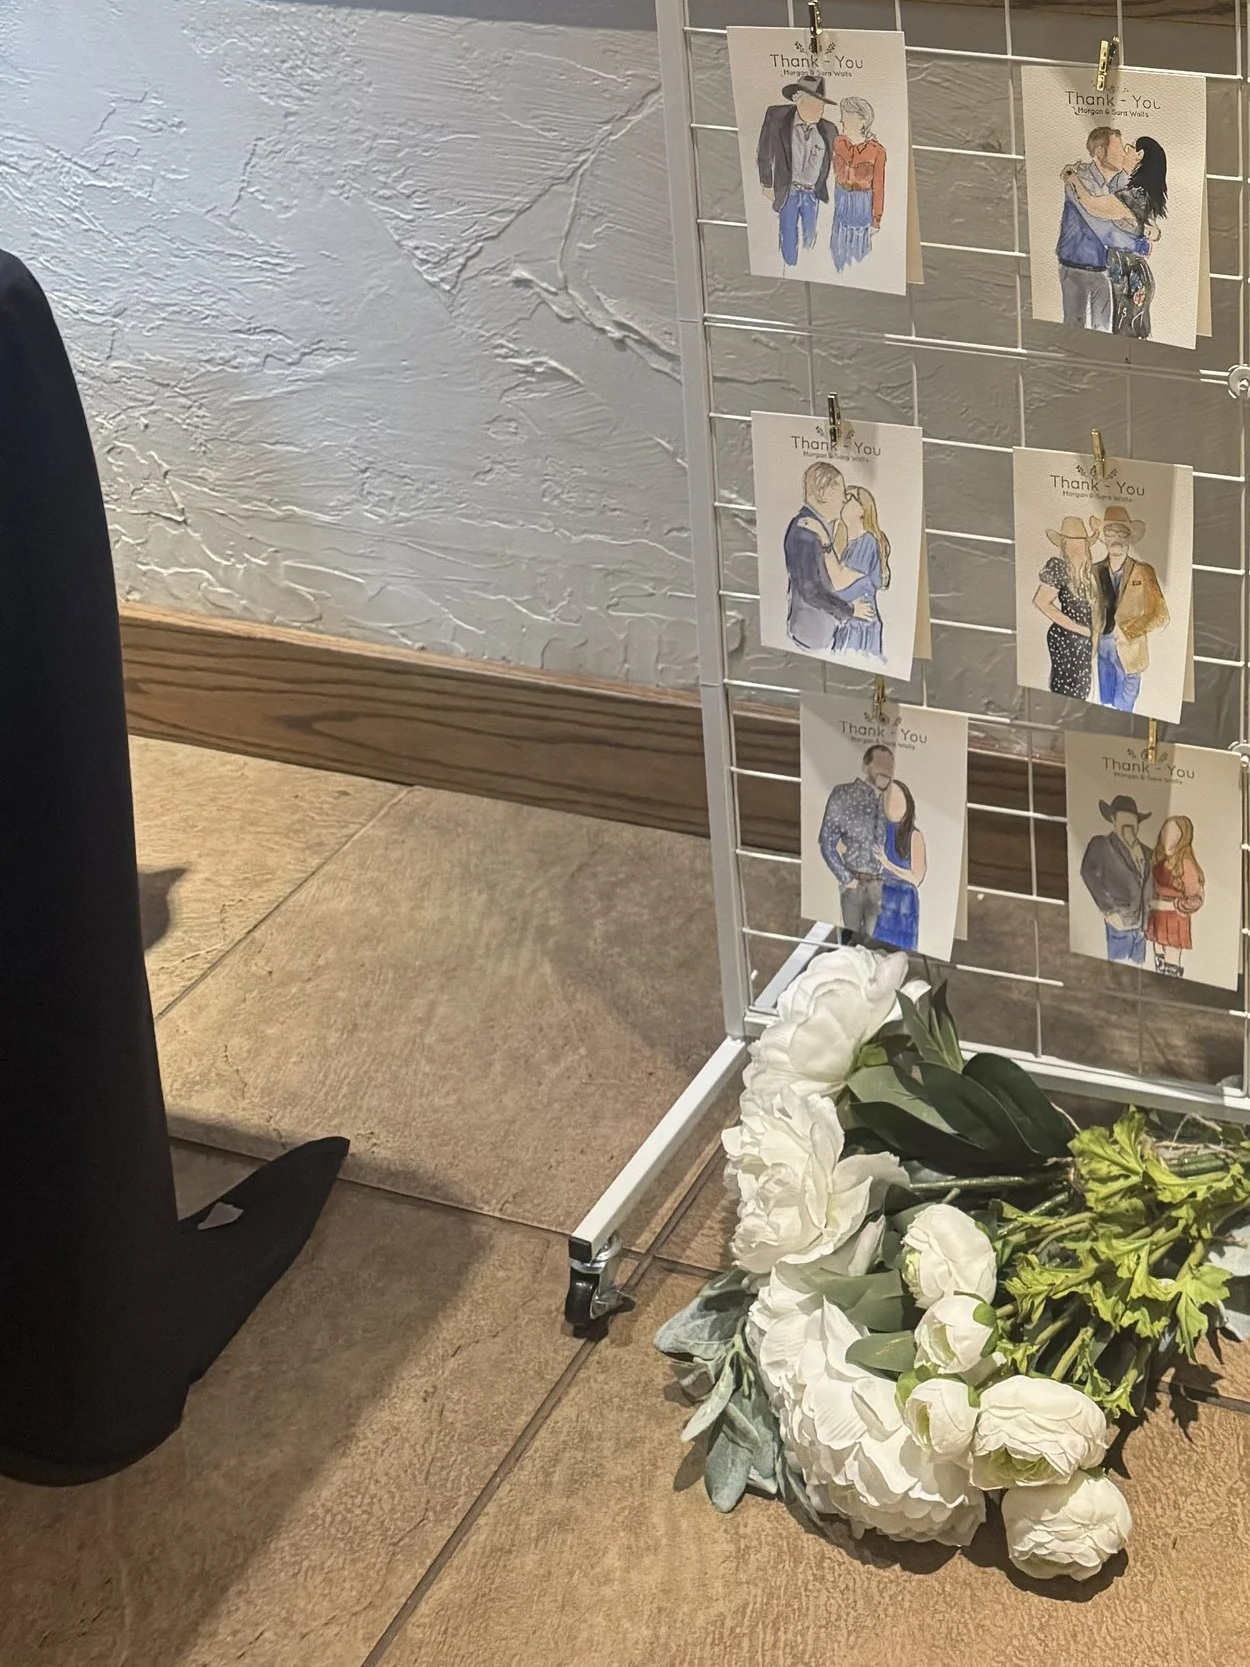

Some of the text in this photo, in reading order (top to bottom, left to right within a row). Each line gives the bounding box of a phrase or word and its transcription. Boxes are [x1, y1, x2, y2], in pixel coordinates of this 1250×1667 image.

[769, 53, 819, 68] Thank
[834, 55, 863, 69] You
[783, 69, 809, 77] Morgan
[817, 69, 832, 77] Sara
[1065, 90, 1115, 107] Thank
[1132, 94, 1162, 110] You
[1077, 106, 1104, 116] Morgan
[1111, 108, 1128, 117] Sara
[790, 435, 838, 452] Thank
[854, 441, 881, 457] You
[1050, 474, 1099, 492] Thank
[1116, 481, 1145, 496] You
[1062, 489, 1088, 499] Morgan
[839, 720, 885, 738] Thank
[900, 727, 928, 744] You
[1101, 755, 1150, 774] Thank
[1167, 763, 1195, 780] You
